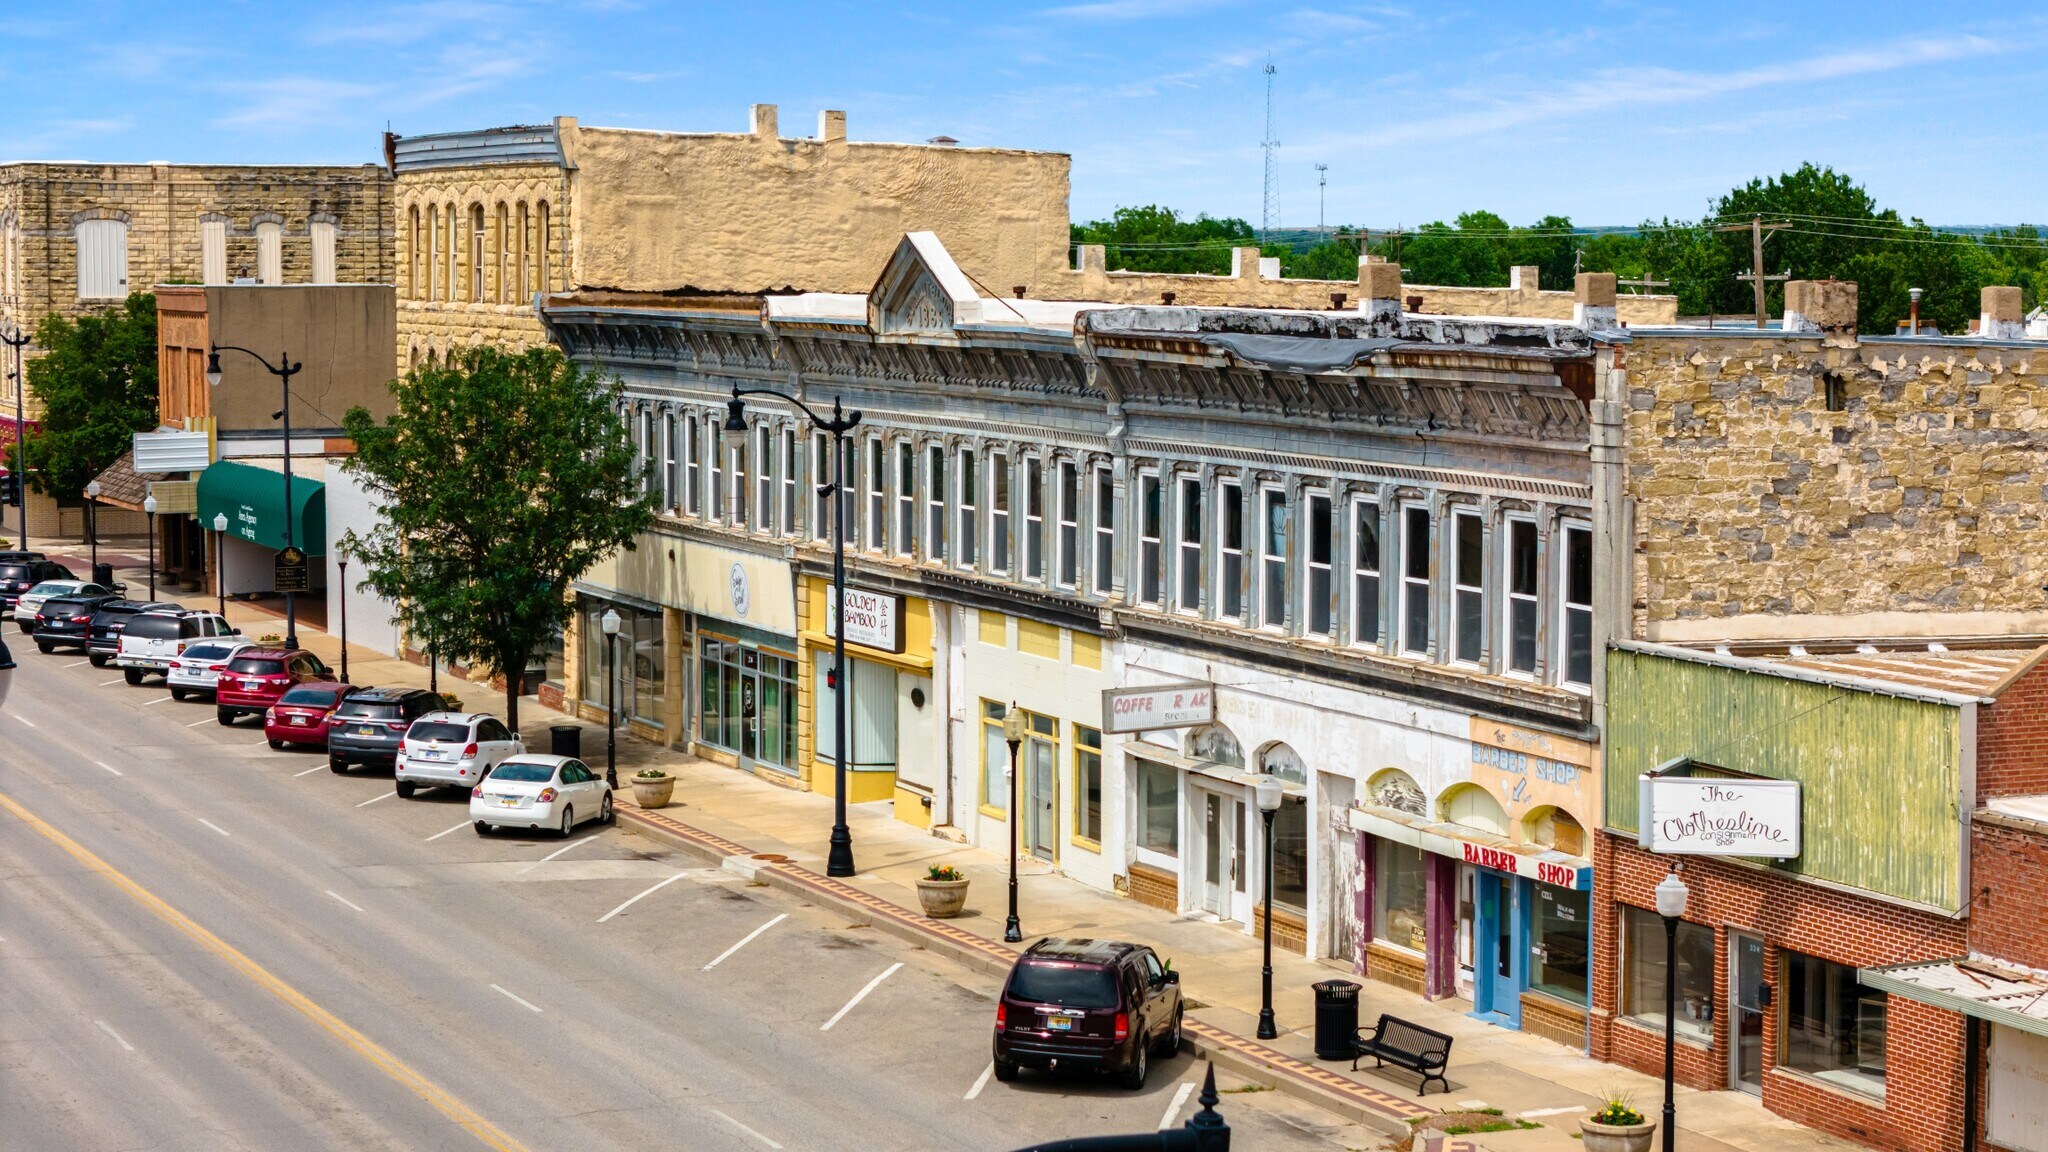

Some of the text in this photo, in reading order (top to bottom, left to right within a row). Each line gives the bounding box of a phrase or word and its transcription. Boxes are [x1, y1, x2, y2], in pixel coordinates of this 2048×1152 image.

[844, 592, 877, 612] GOLDEN
[844, 609, 877, 629] BAMBOO
[1472, 741, 1527, 776] BARBER
[1701, 785, 1744, 803] The
[1663, 810, 1789, 842] Clothesline
[1463, 842, 1575, 887] BARBER SHOP
